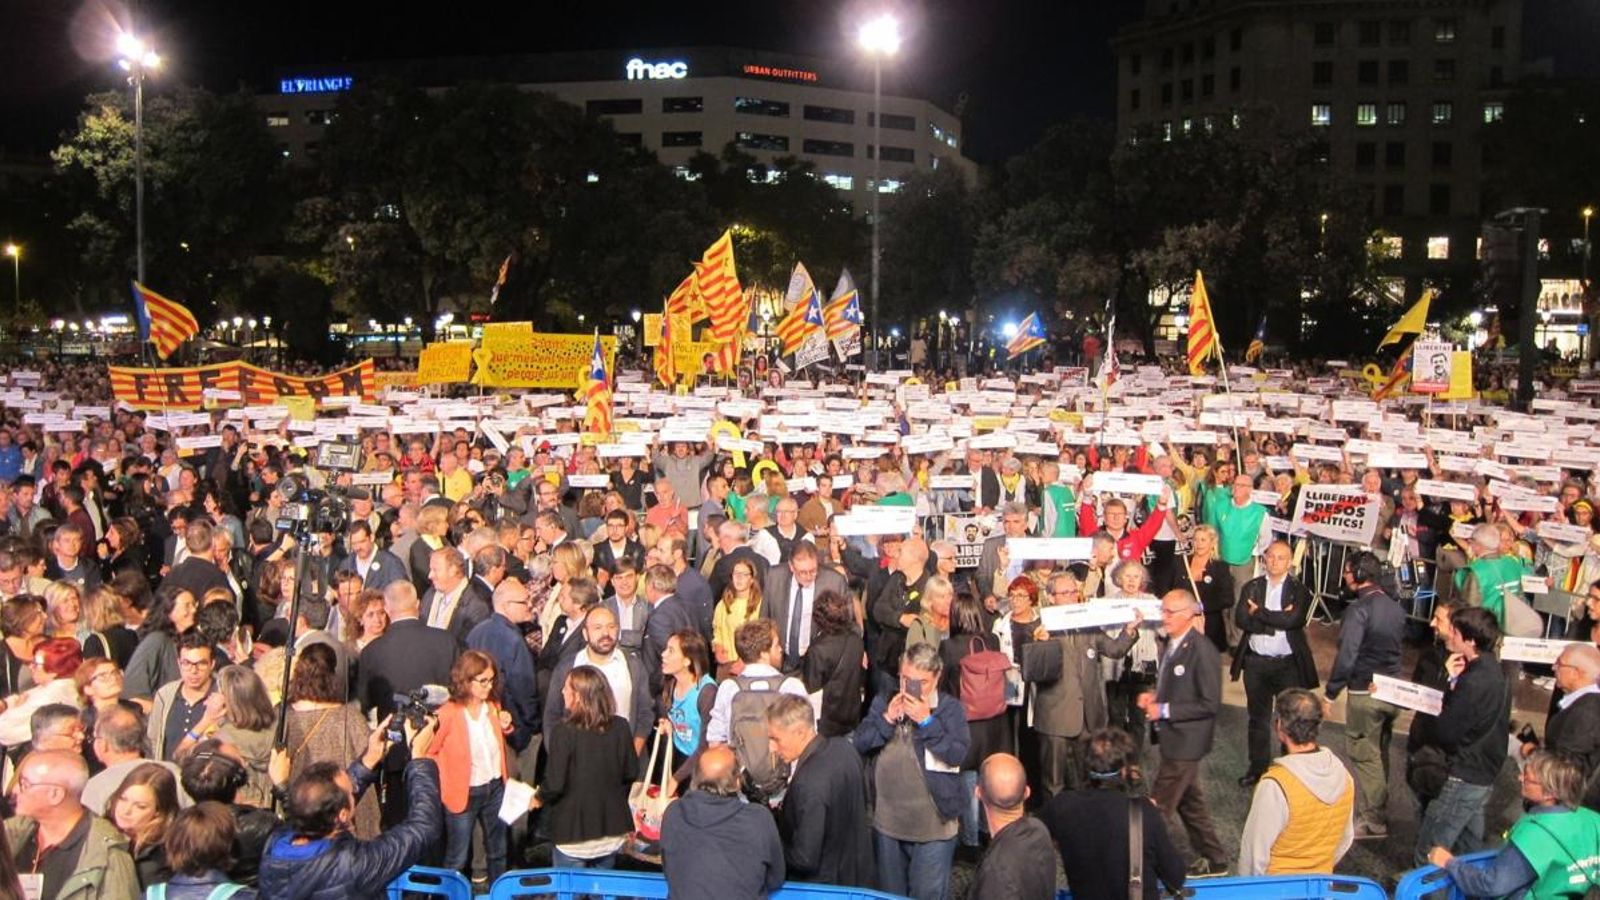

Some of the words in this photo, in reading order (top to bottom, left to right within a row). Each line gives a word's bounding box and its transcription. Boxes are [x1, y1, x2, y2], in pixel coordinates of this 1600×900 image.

[626, 57, 688, 80] fnac
[744, 65, 771, 76] URBAN
[772, 68, 817, 82] OUTFITTERS
[281, 80, 295, 93] EL
[1306, 491, 1368, 505] LLIBERTAT
[1305, 500, 1366, 517] PRESOS
[1303, 511, 1364, 529] POLITICS!
